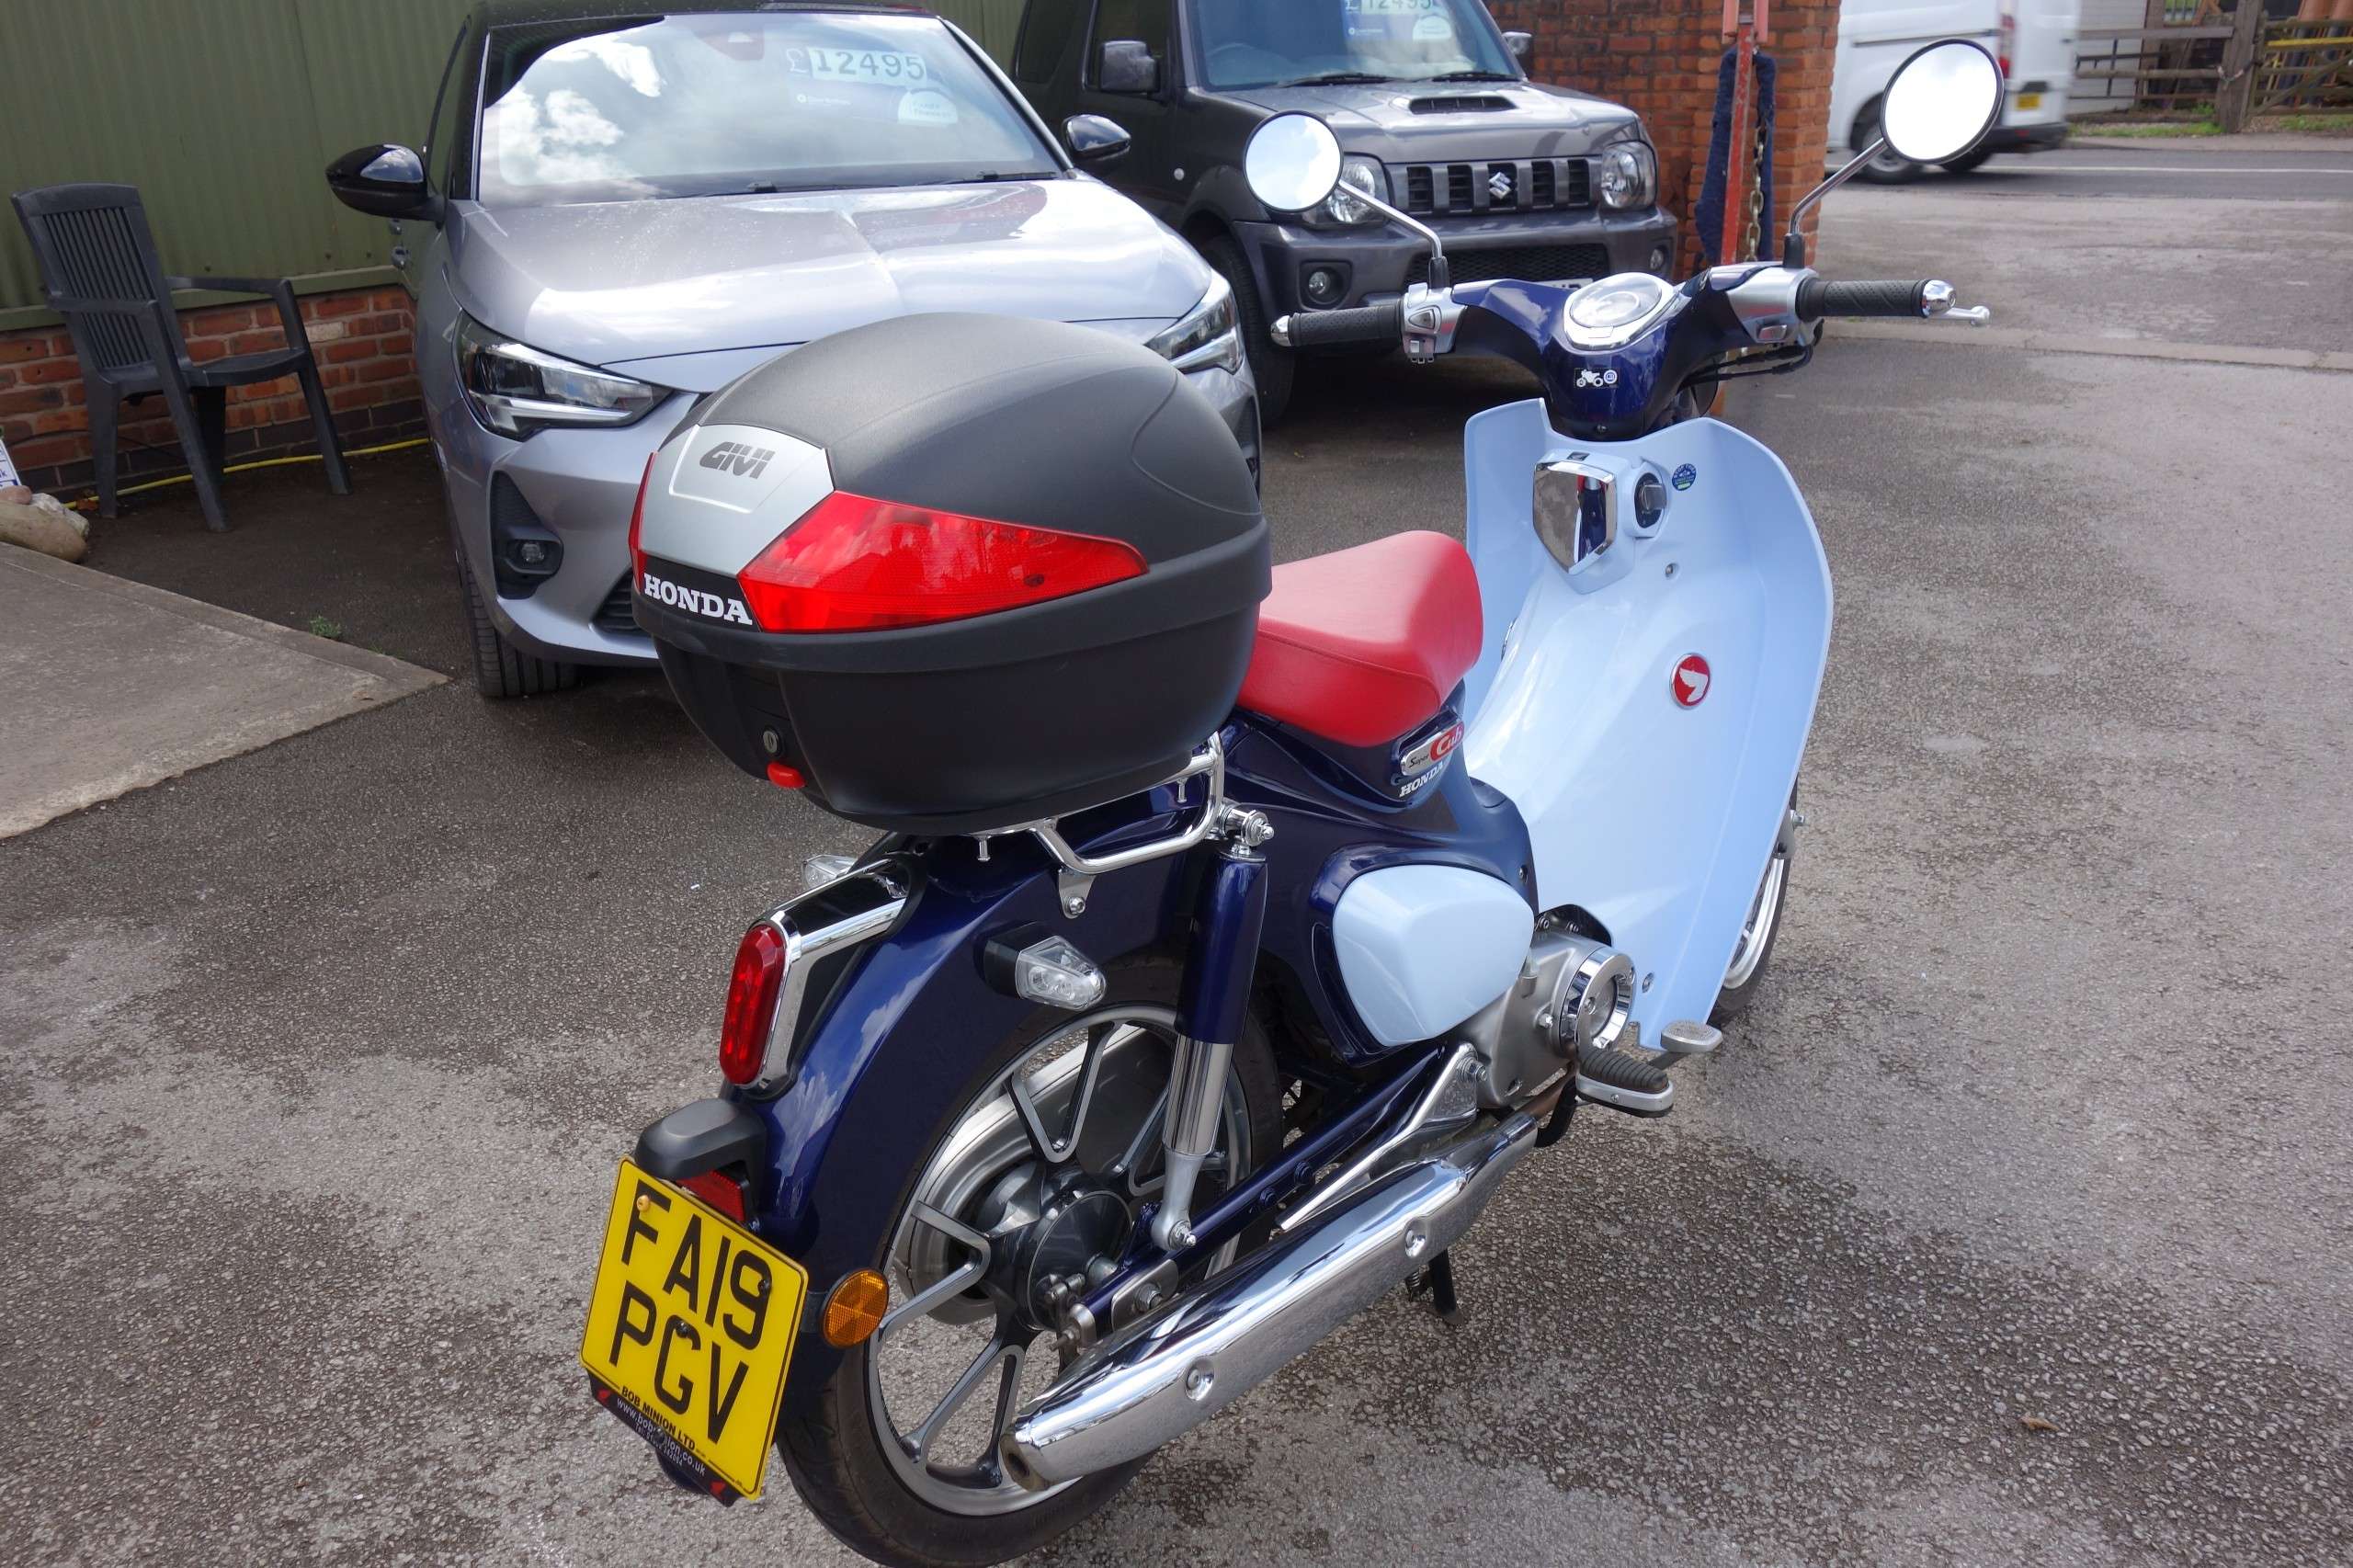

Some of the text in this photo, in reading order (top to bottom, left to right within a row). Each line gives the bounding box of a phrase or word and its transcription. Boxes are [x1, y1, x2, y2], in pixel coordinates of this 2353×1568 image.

[699, 441, 776, 480] GIVI
[643, 573, 753, 626] HONDA
[1436, 725, 1463, 756] Cub
[1399, 761, 1443, 798] HONDA
[621, 1178, 773, 1351] FA19
[608, 1279, 749, 1445] PGV
[617, 1397, 707, 1476] www.bobion.co.uk
[621, 1386, 641, 1407] BOB
[642, 1402, 676, 1436] MINION
[678, 1429, 696, 1451] LTD
